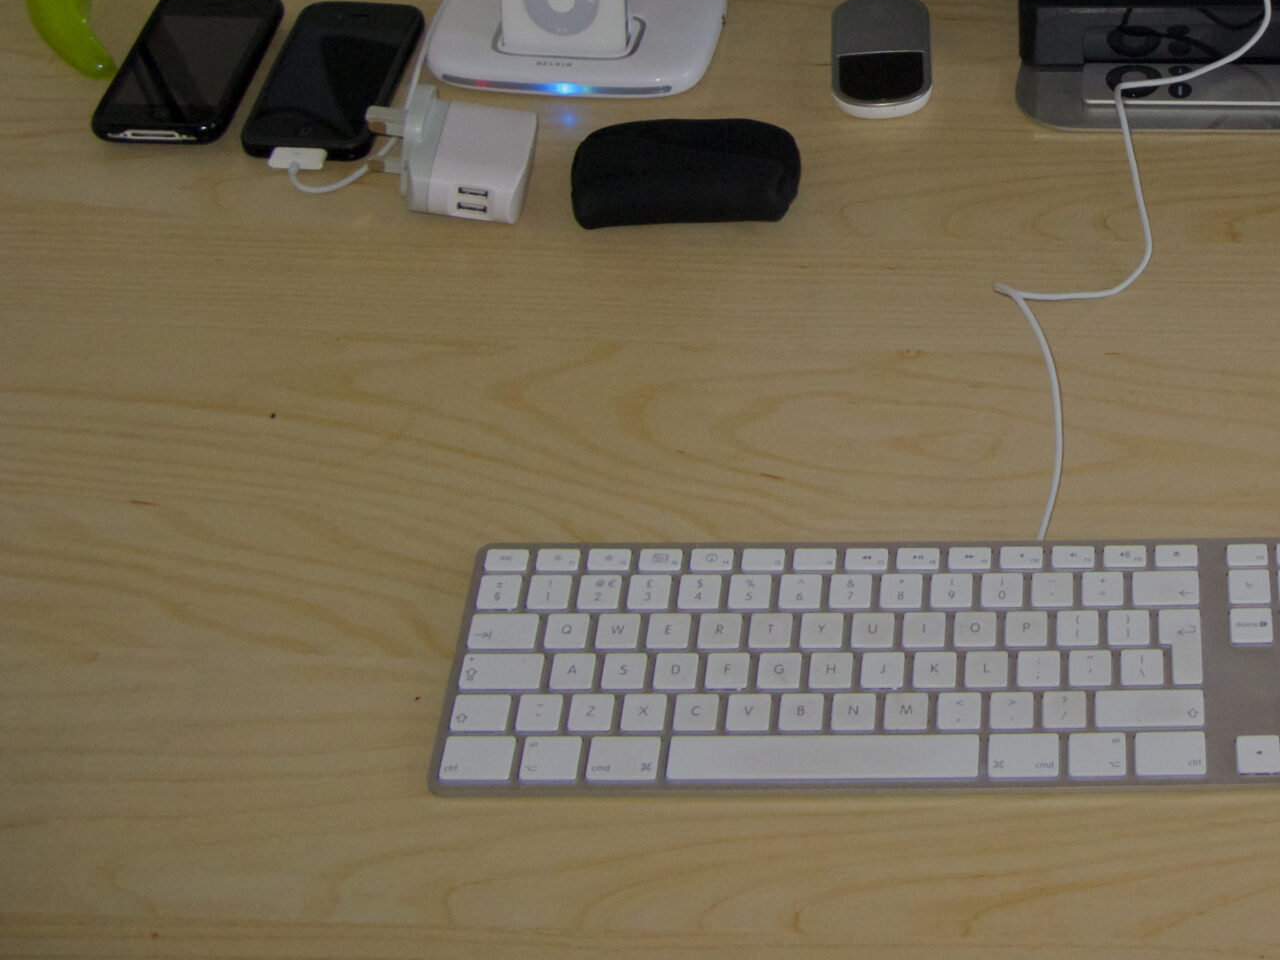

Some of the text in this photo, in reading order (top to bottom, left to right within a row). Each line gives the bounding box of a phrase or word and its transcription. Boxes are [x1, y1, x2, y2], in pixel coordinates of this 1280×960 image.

[593, 591, 603, 603] 2
[643, 591, 652, 603] 3
[693, 591, 702, 601] 4
[744, 591, 753, 602] 5
[795, 591, 804, 602] 6
[847, 590, 855, 601] 7
[896, 590, 905, 601] 8
[947, 590, 956, 600] 9
[997, 589, 1007, 601] 0
[560, 623, 573, 635] Q
[611, 624, 625, 635] W
[664, 624, 673, 636] E
[714, 623, 725, 635] R
[767, 623, 775, 635] T
[817, 623, 826, 634] Y
[867, 623, 878, 635] U
[969, 622, 981, 634] O
[1022, 621, 1031, 633] P
[566, 664, 577, 675] A
[619, 664, 628, 676] S
[670, 663, 681, 676] D
[723, 663, 732, 675] F
[773, 663, 785, 676] G
[825, 663, 837, 675] H
[929, 663, 940, 674] K
[585, 704, 913, 717] Z X C V B N M
